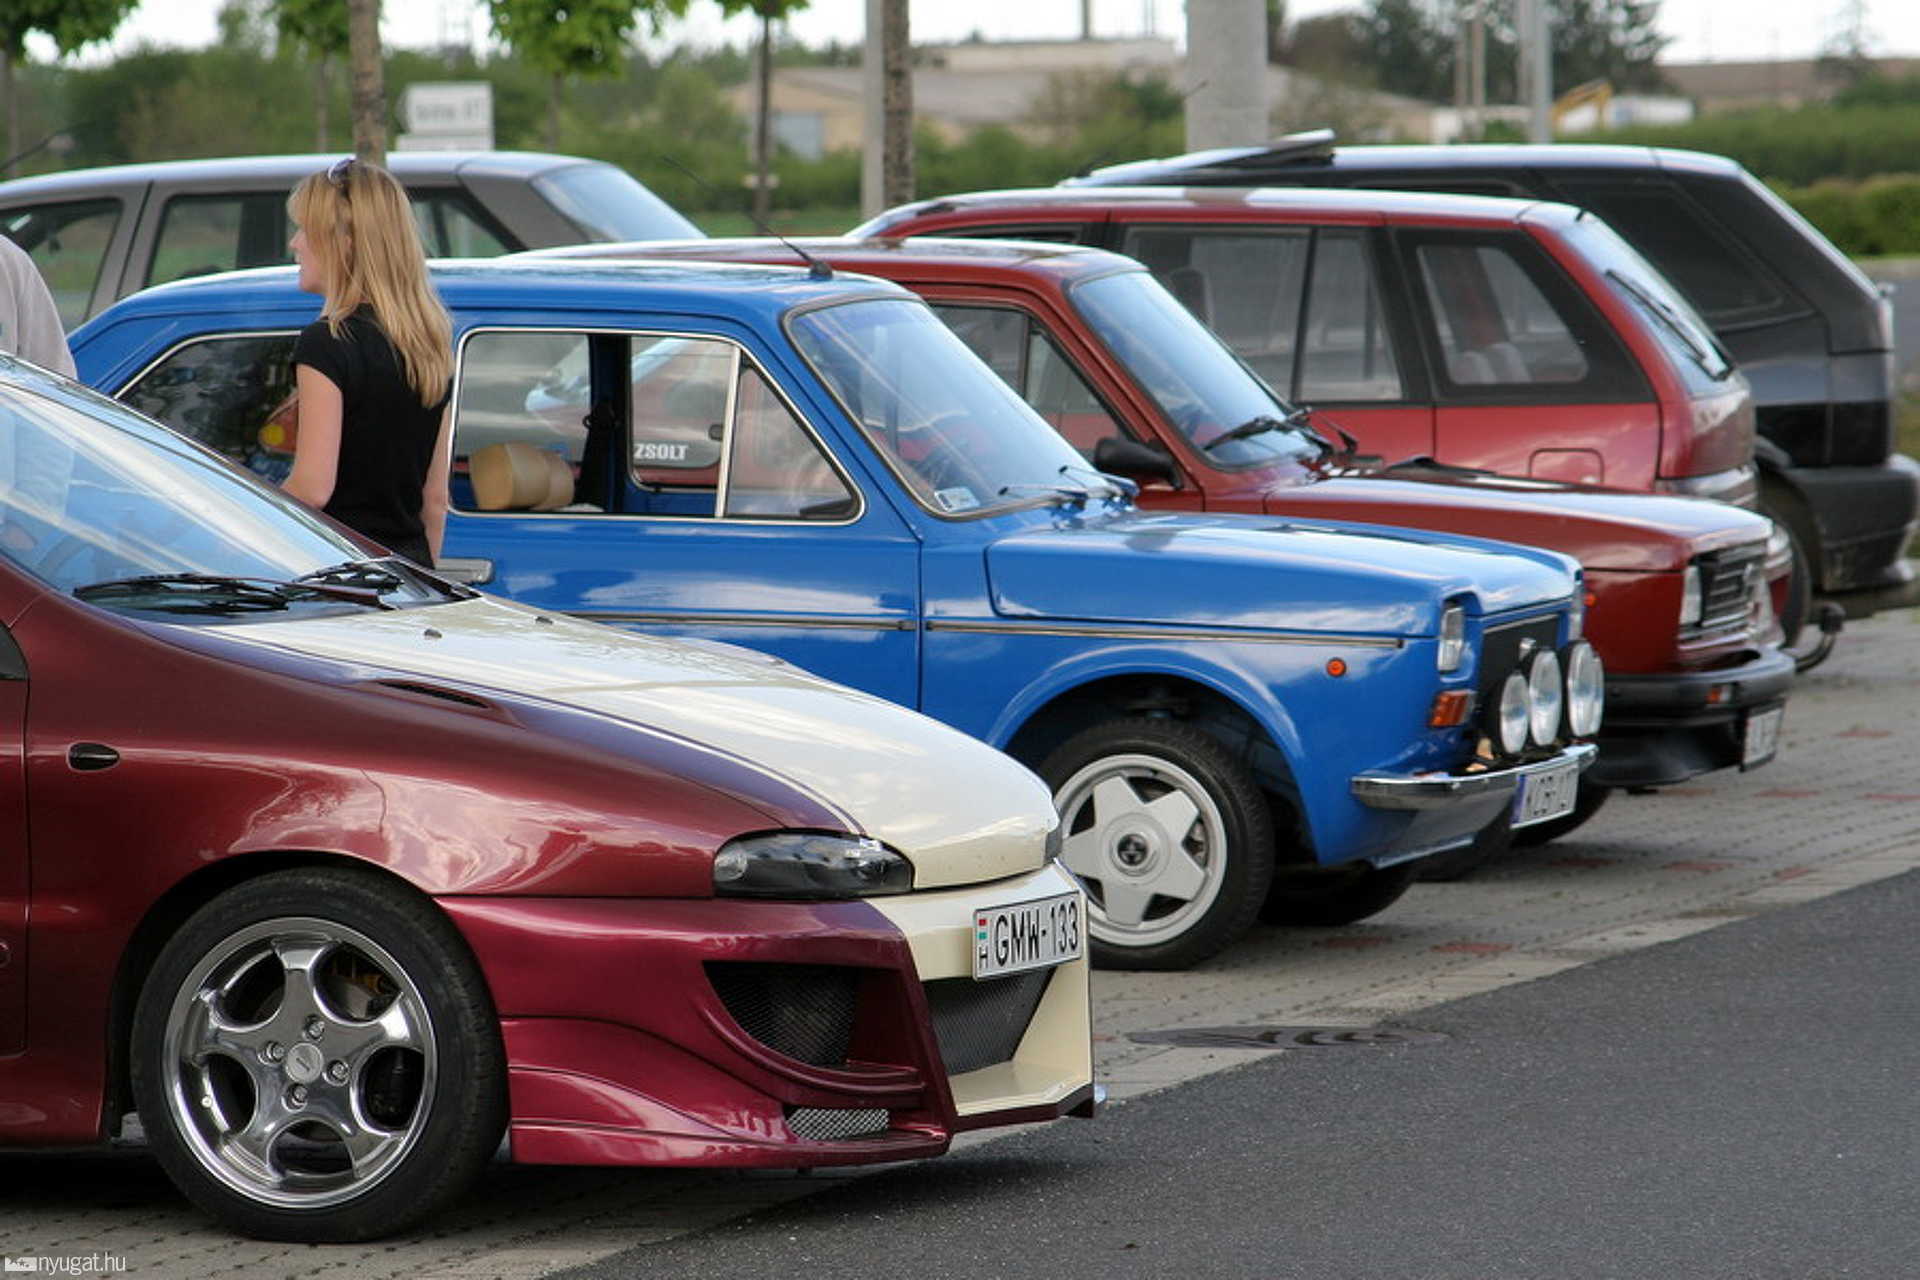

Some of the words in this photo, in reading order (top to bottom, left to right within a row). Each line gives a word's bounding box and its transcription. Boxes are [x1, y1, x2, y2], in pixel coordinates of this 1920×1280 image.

[633, 443, 688, 460] ZSOLT
[995, 901, 1078, 967] GMW-133
[979, 945, 988, 969] H
